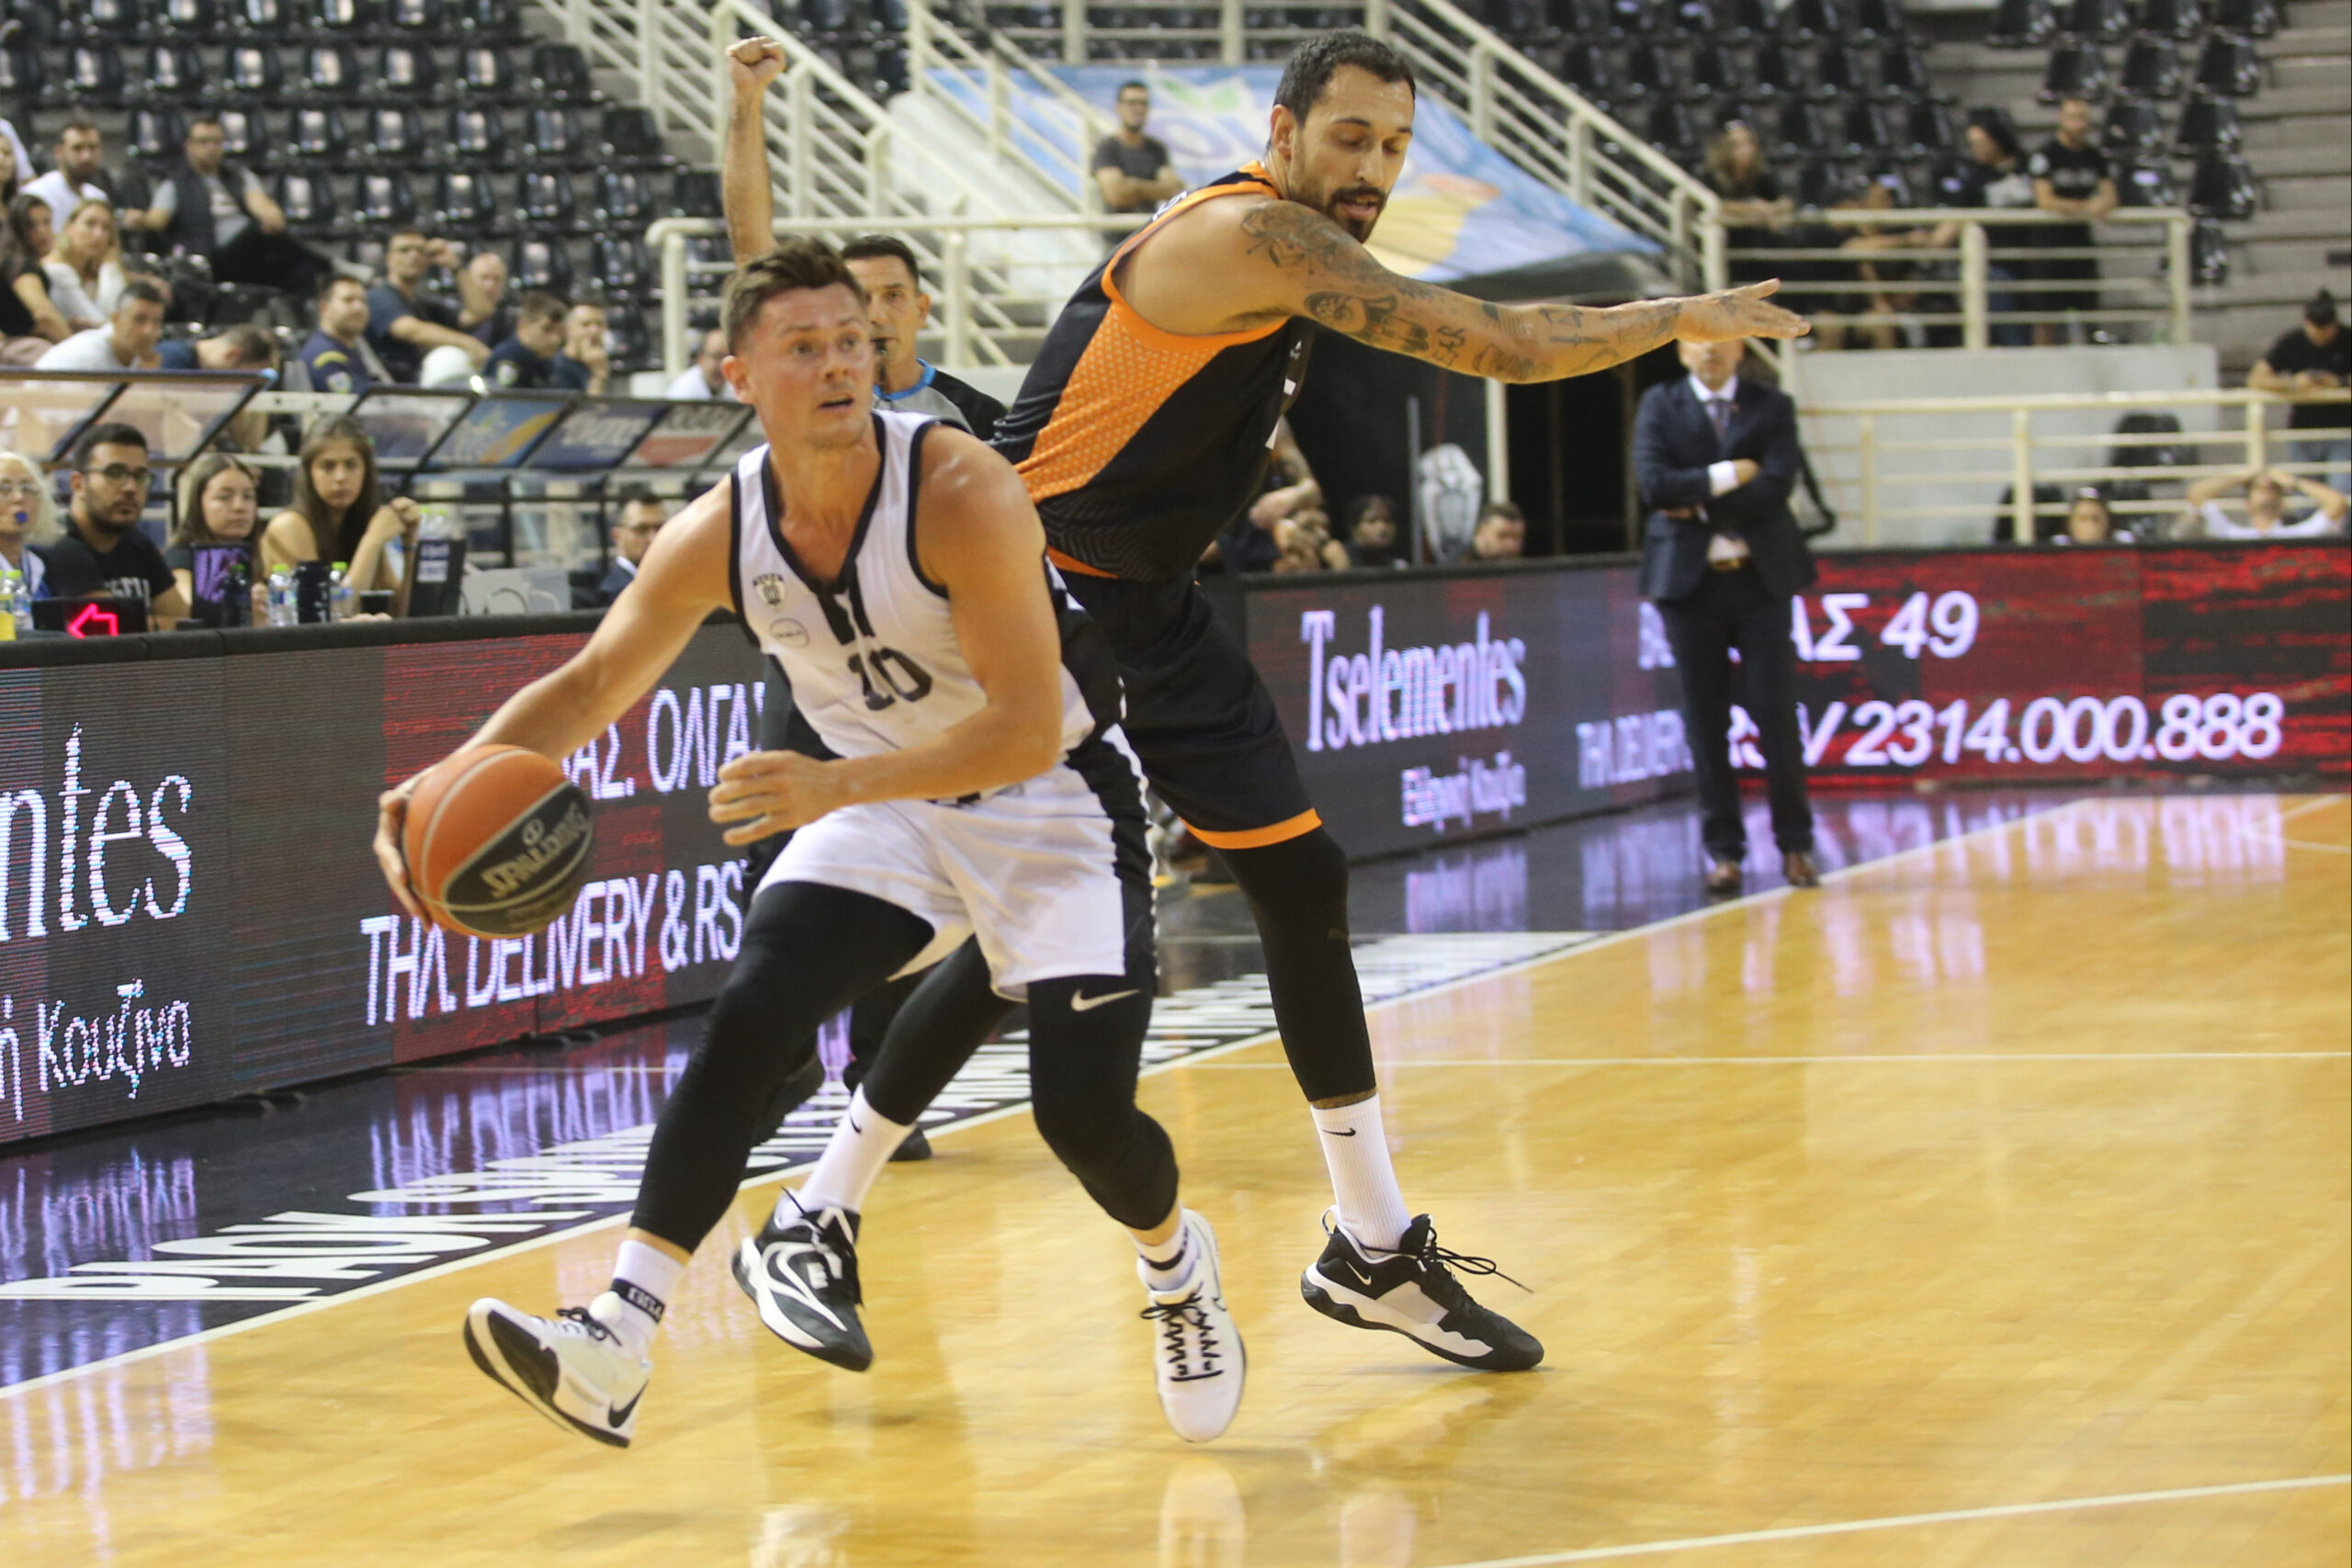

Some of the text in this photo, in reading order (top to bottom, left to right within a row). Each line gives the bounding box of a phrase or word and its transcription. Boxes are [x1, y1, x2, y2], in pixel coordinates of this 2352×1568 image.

[1880, 591, 1981, 660] 49
[847, 646, 933, 711] 10
[1301, 604, 1527, 751] Tselementes
[562, 721, 636, 800] ΑΣ.
[1844, 693, 2284, 766] 2314.000.888
[466, 874, 659, 1008] DELIVERY
[659, 868, 690, 972] &
[0, 1210, 595, 1302] PAOK
